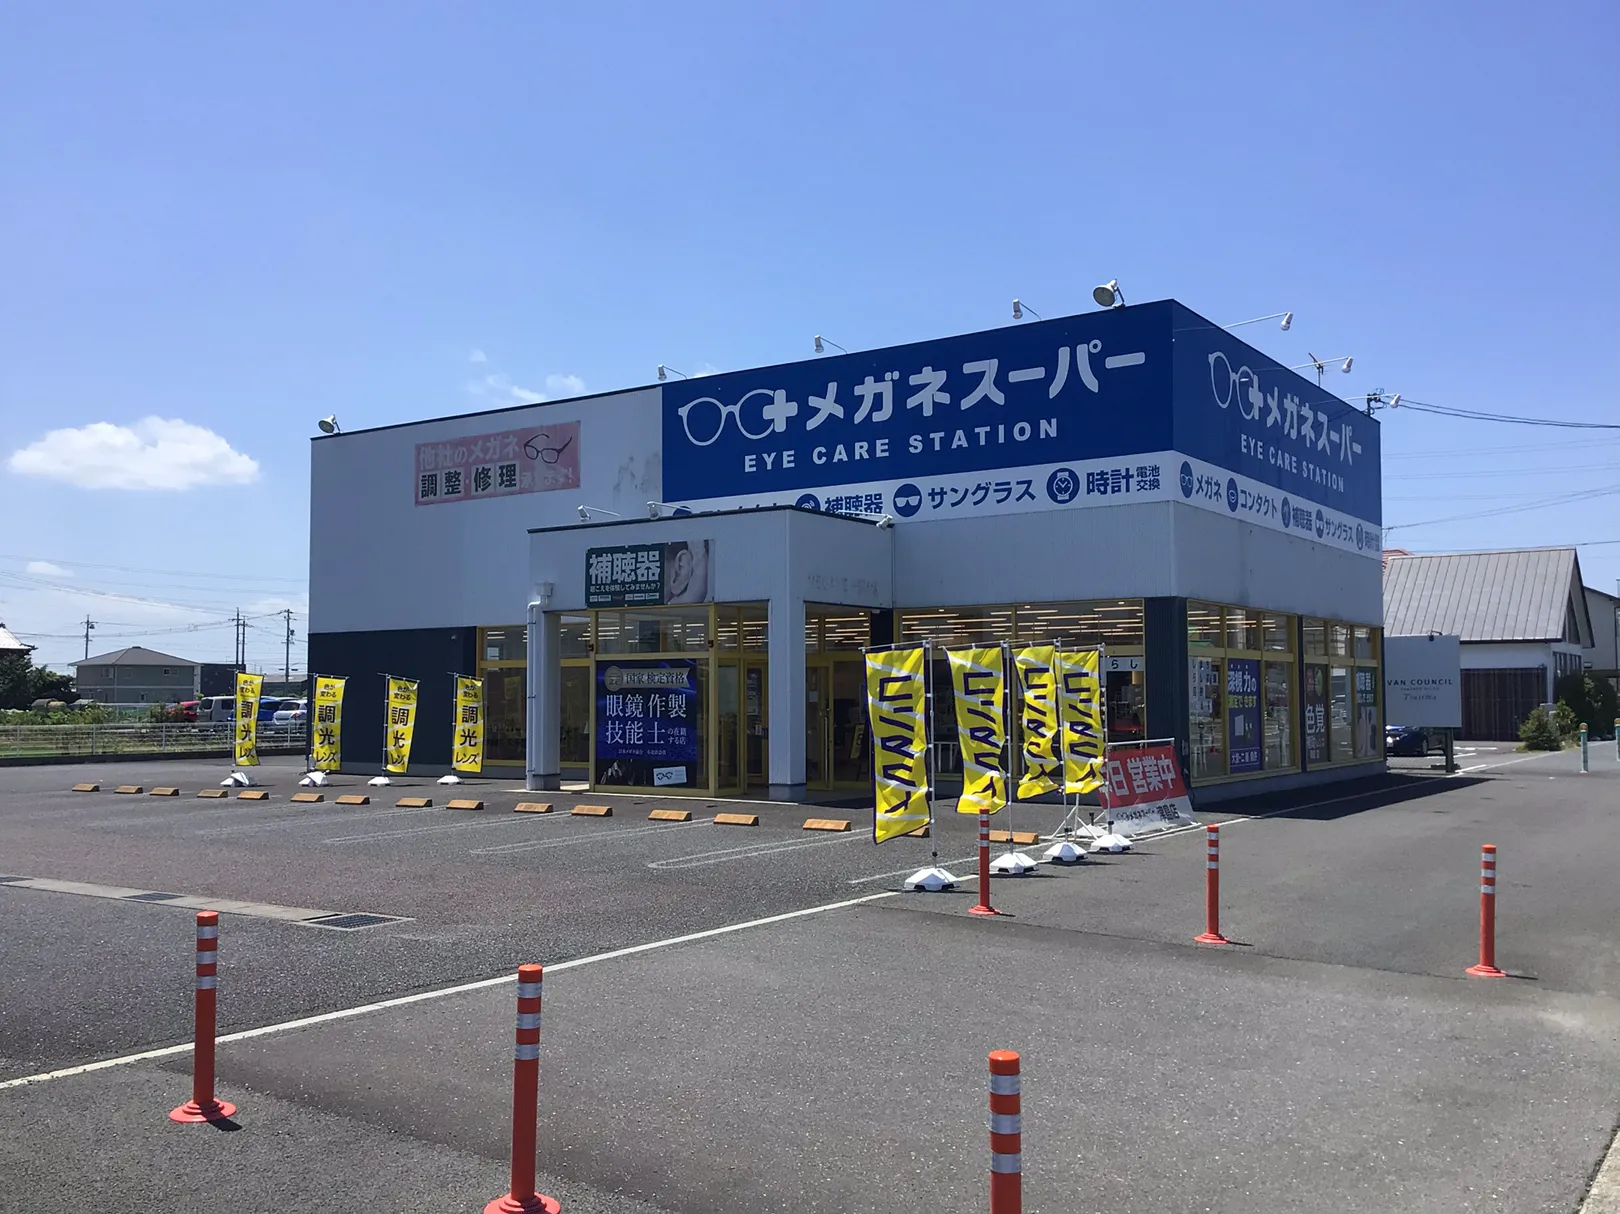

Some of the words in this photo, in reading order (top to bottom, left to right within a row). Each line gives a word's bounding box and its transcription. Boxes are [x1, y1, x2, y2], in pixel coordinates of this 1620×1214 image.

[806, 339, 1146, 431] メガネスーパー
[1266, 386, 1362, 466] メガネスーパー
[744, 449, 795, 472] EYE
[812, 438, 890, 465] CARE
[908, 417, 1058, 454] STATION
[1136, 464, 1160, 478] 電池
[1241, 433, 1264, 460] EYE
[1269, 446, 1297, 474] CARE
[1302, 461, 1344, 493] STATION
[928, 479, 1036, 508] サングラス
[1086, 467, 1134, 495] 時計
[1136, 478, 1160, 492] 交換
[1195, 474, 1222, 502] メガネ
[1240, 489, 1277, 519] コンタクト
[1325, 517, 1353, 543] サングラス
[589, 551, 660, 584] 補聴器
[1410, 678, 1453, 686] COUNCIL
[606, 693, 687, 718] 眼鏡作製
[606, 720, 666, 745] 技能士
